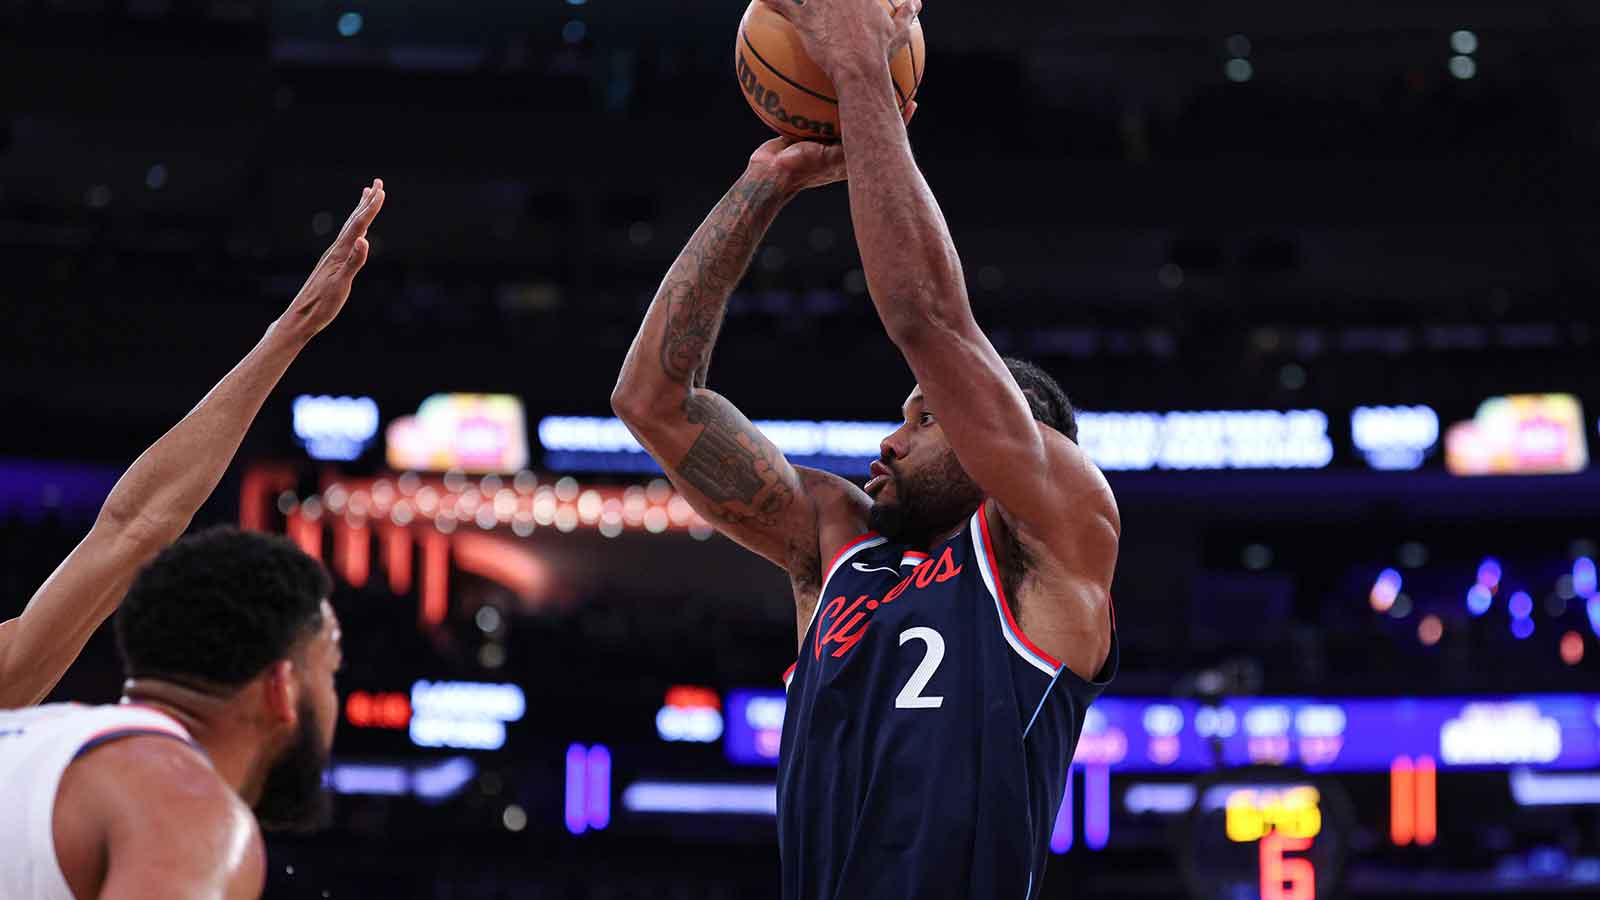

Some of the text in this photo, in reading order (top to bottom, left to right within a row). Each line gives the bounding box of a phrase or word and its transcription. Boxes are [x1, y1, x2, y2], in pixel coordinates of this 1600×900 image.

[737, 52, 835, 135] Wilson
[815, 547, 963, 662] Cliers
[895, 626, 946, 709] 2
[1258, 833, 1317, 900] 6
